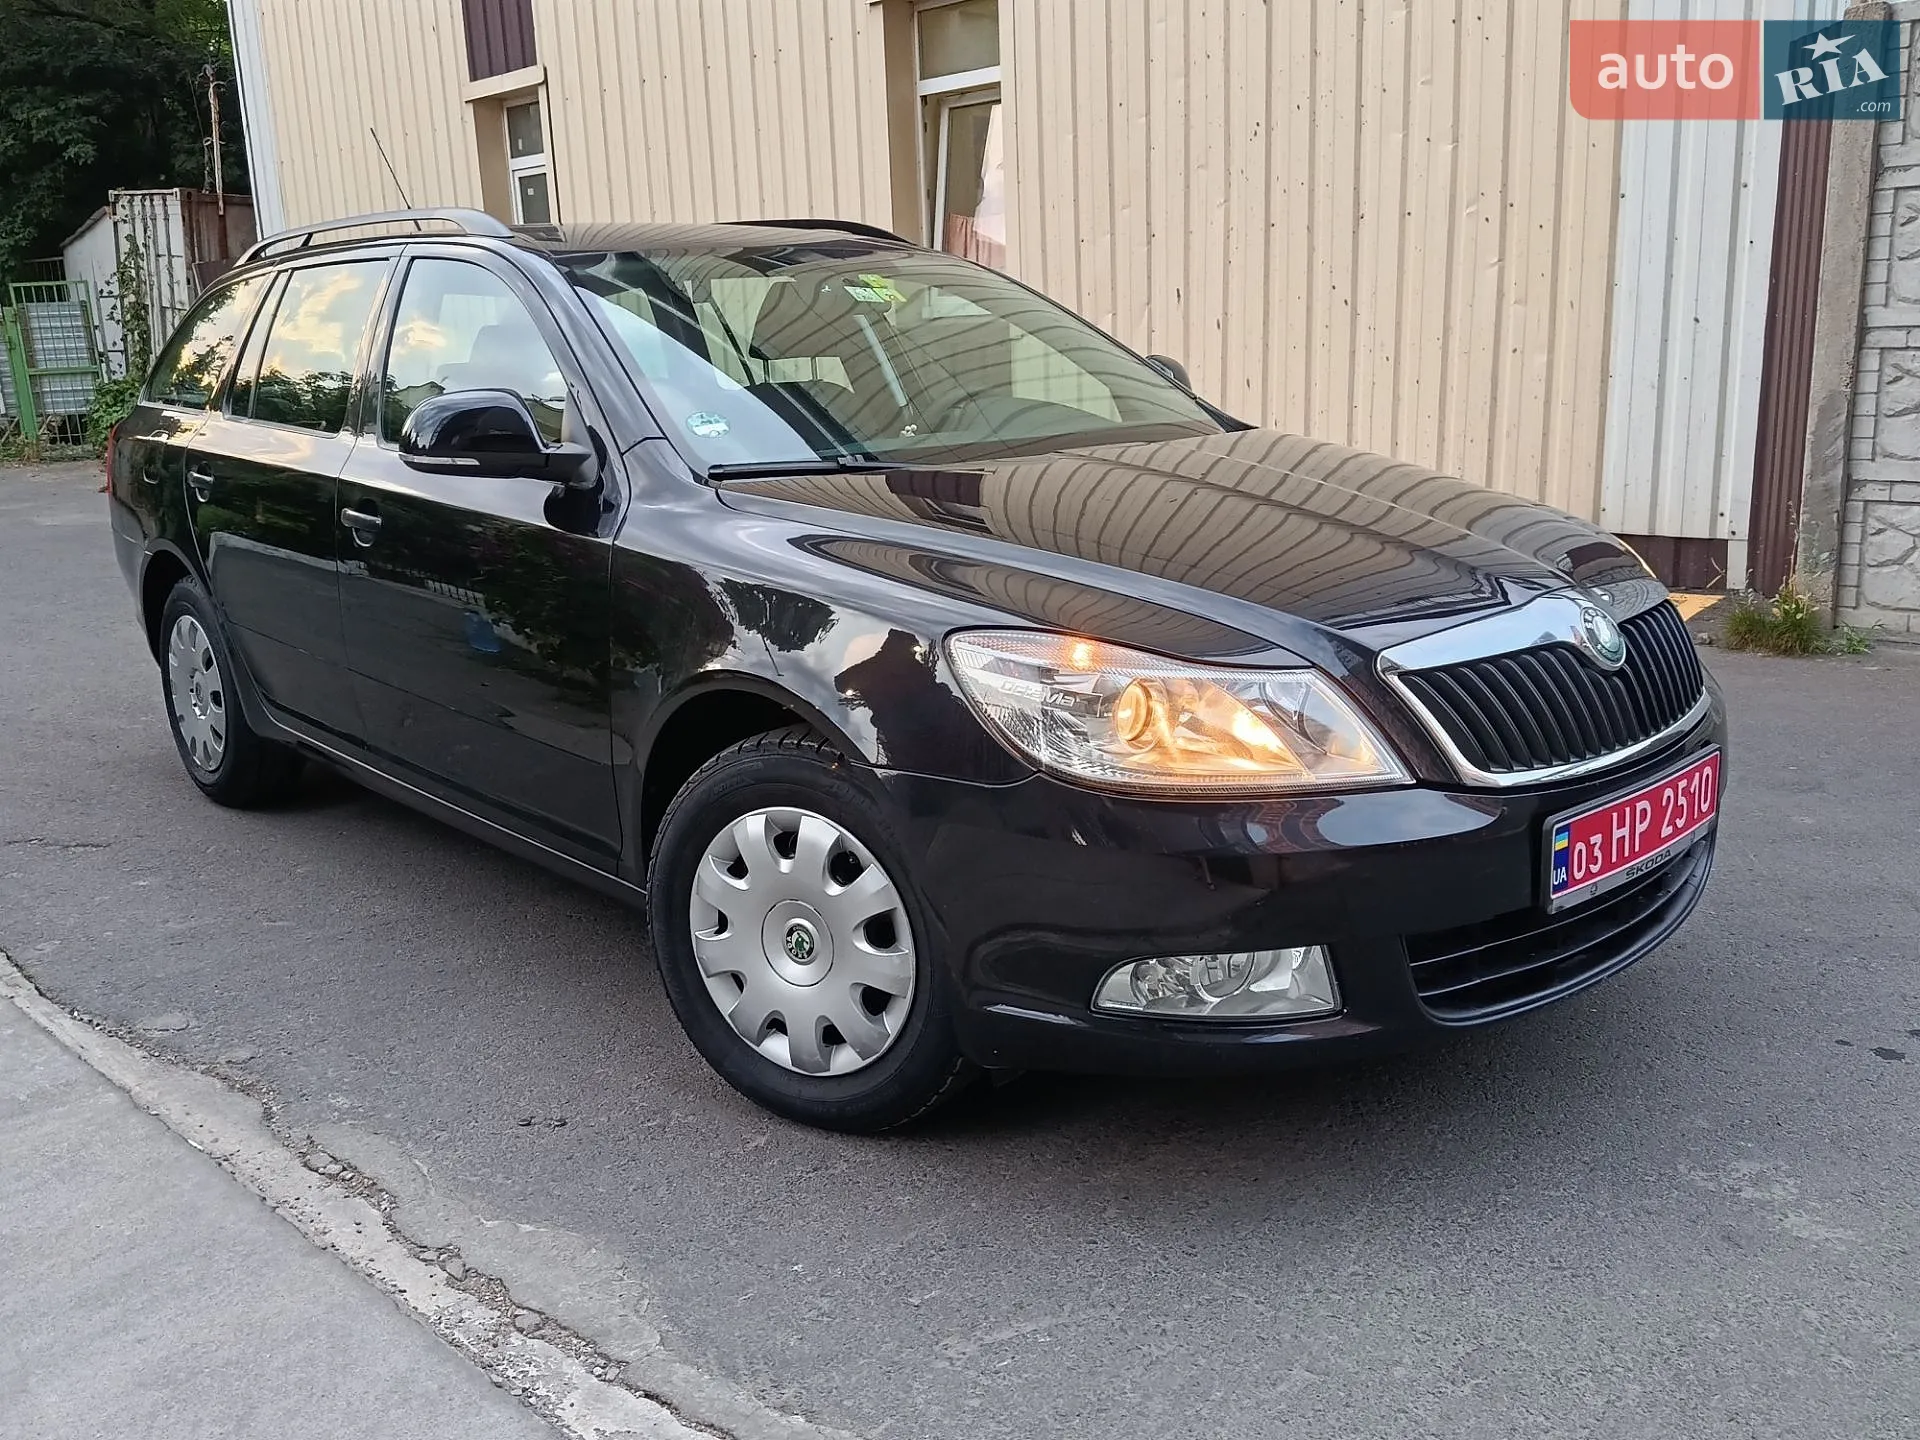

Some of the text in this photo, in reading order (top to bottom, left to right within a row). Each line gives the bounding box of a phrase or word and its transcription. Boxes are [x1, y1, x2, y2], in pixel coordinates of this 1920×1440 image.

[1573, 766, 1713, 880] 03 HP 2510
[1553, 866, 1567, 885] UA
